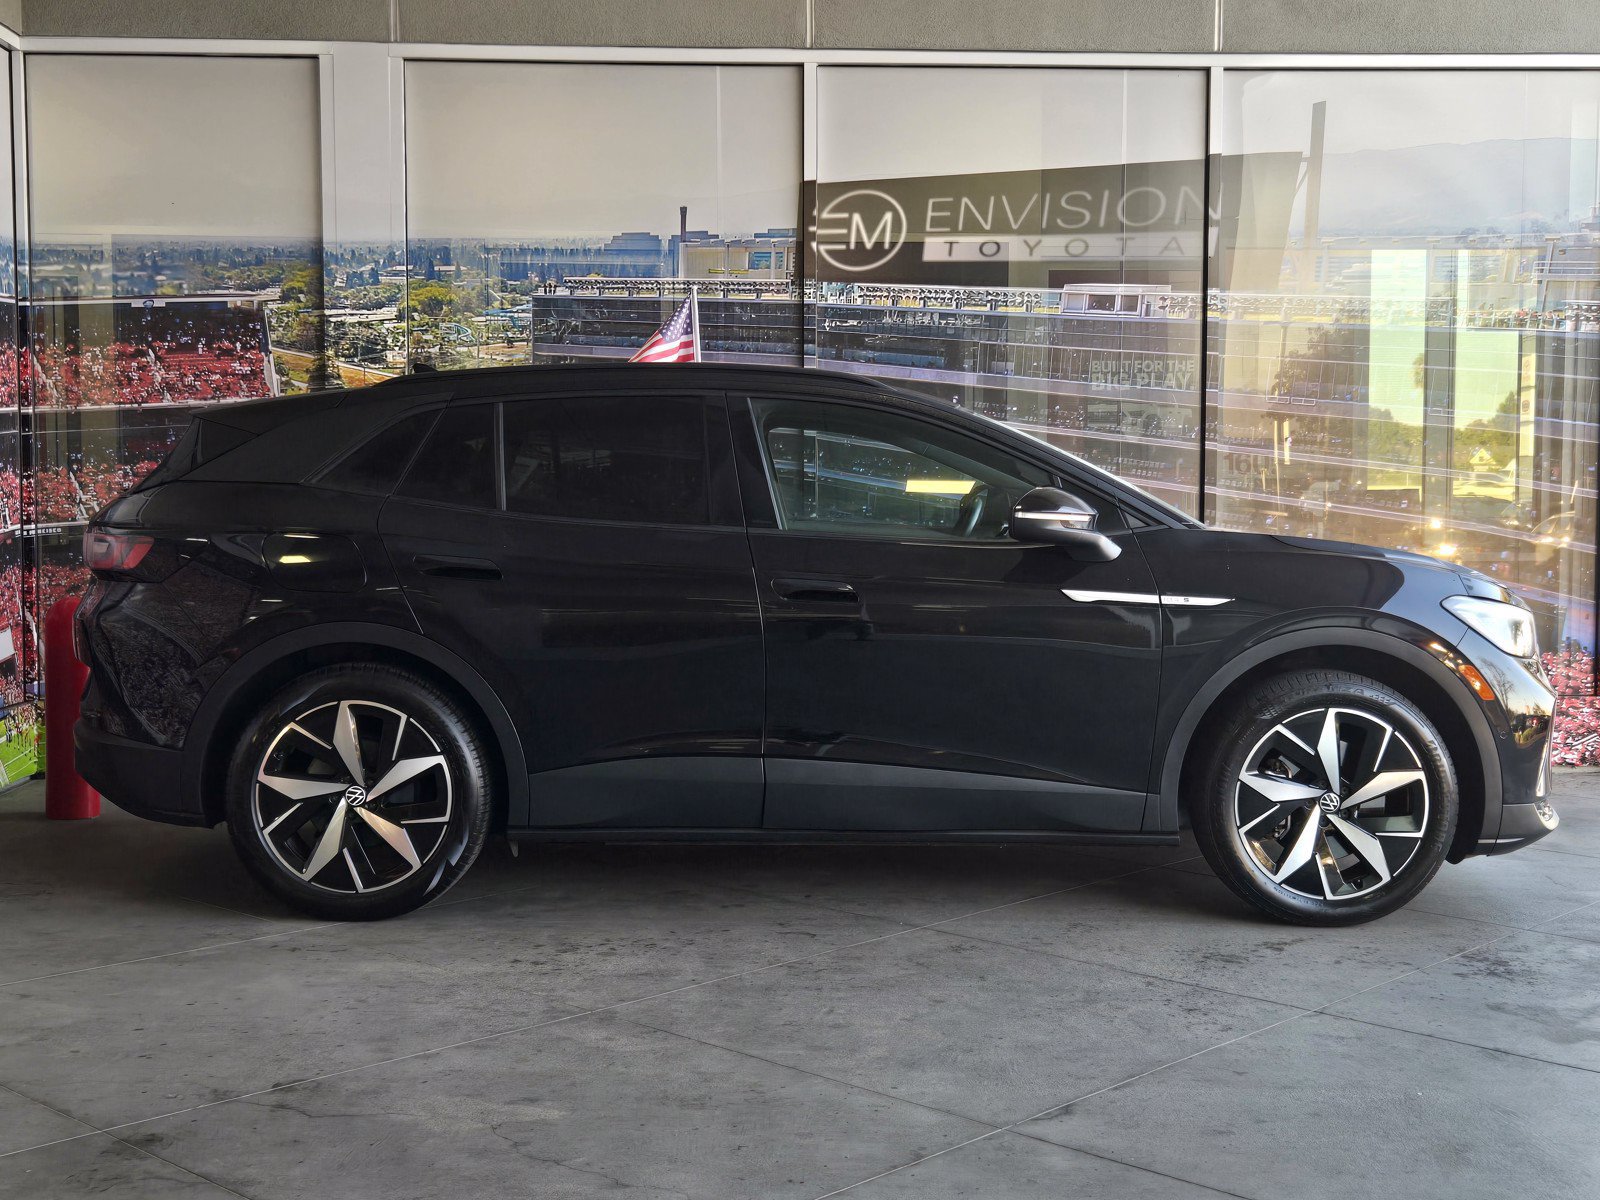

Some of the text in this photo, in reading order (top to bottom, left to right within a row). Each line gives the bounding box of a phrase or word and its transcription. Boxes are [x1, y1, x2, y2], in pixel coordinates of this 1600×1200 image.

[925, 182, 1223, 232] ENVISION
[944, 236, 1185, 258] TOYOTA
[1092, 360, 1195, 373] BUILT FOR THE
